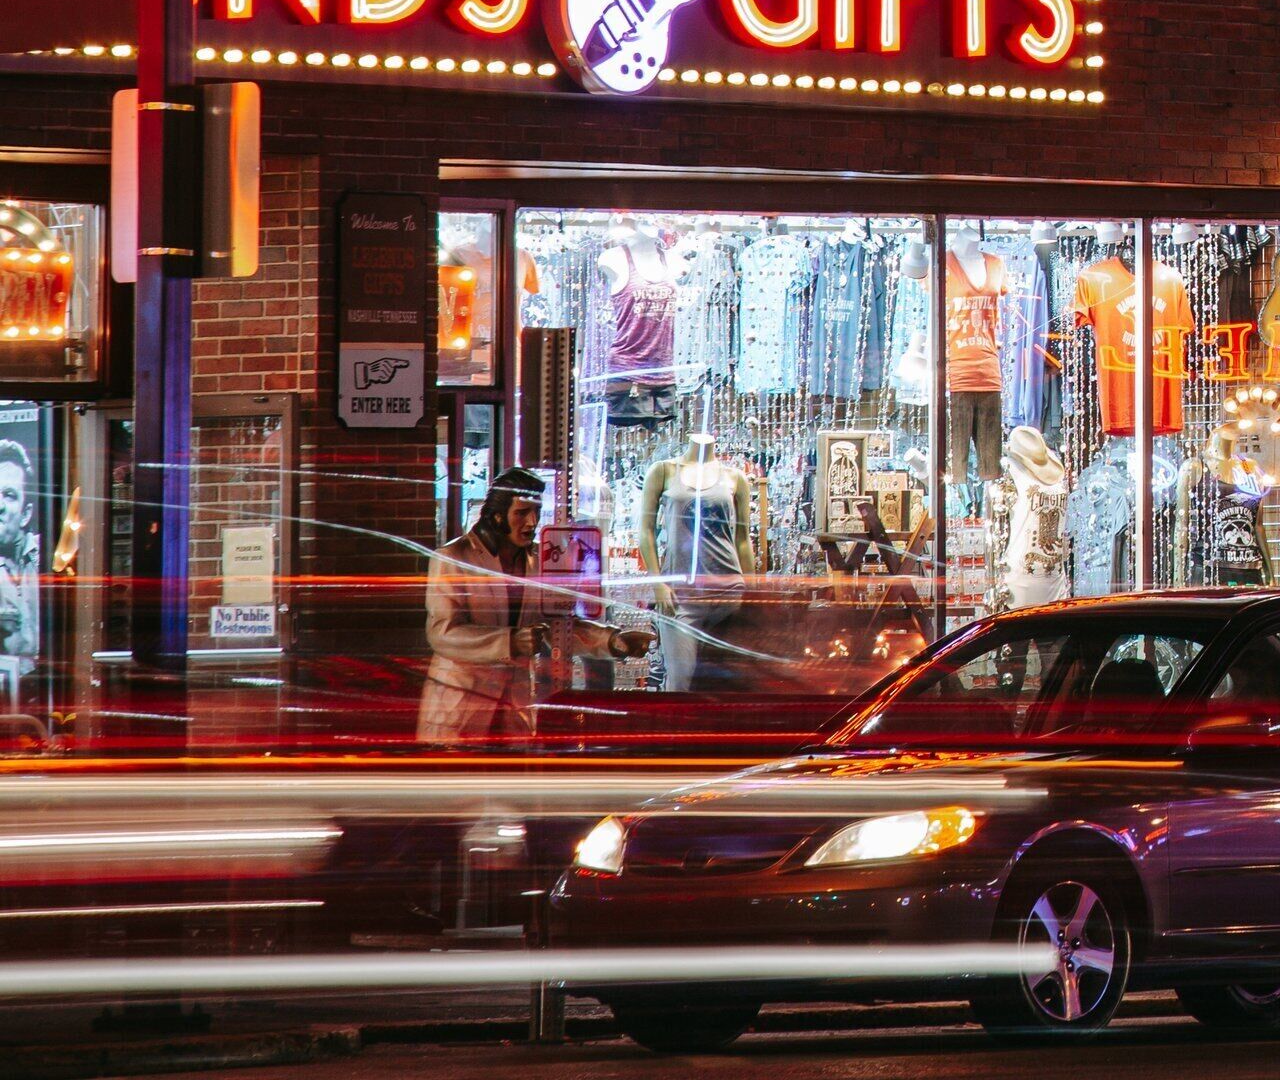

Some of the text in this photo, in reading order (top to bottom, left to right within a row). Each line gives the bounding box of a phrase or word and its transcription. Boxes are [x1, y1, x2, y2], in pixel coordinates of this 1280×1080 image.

[350, 213, 417, 231] Welcome To
[351, 396, 412, 413] ENTER HERE
[216, 608, 271, 621] No Public
[214, 620, 272, 634] Restrooms
